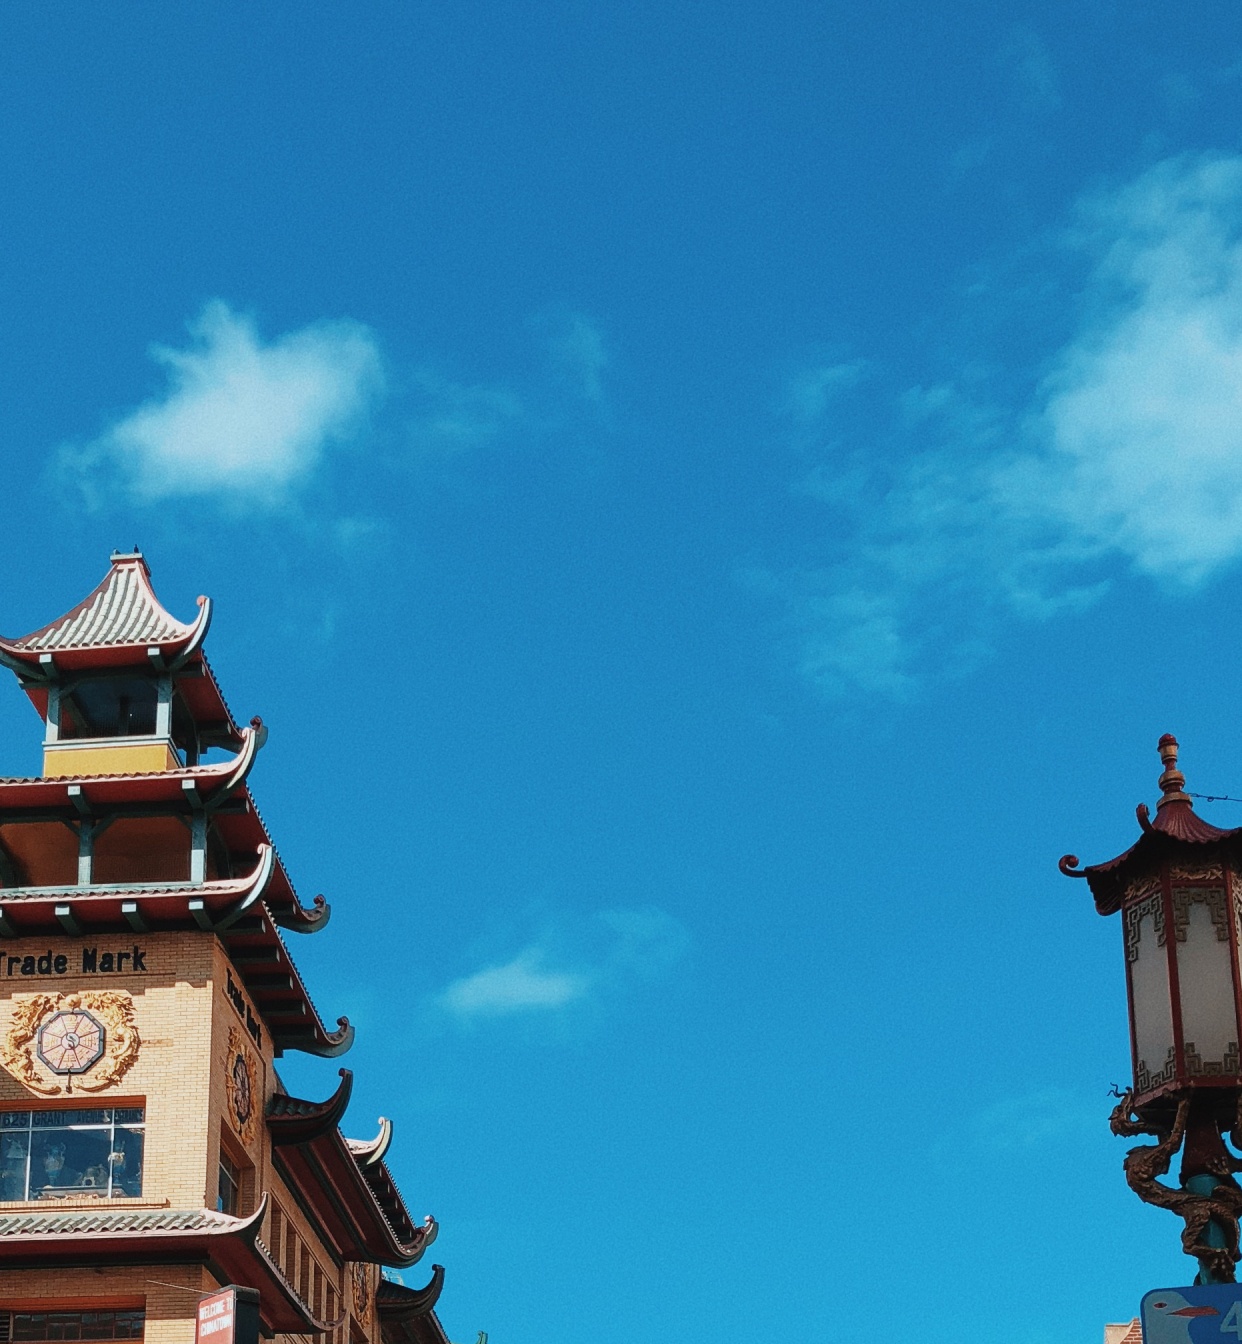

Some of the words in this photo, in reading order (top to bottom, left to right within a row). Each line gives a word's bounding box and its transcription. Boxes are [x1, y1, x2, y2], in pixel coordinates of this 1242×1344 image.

[82, 945, 147, 973] Mark
[33, 1111, 67, 1125] GRANT
[199, 1299, 225, 1320] WELCOME
[200, 1313, 232, 1336] CHINATOWN
